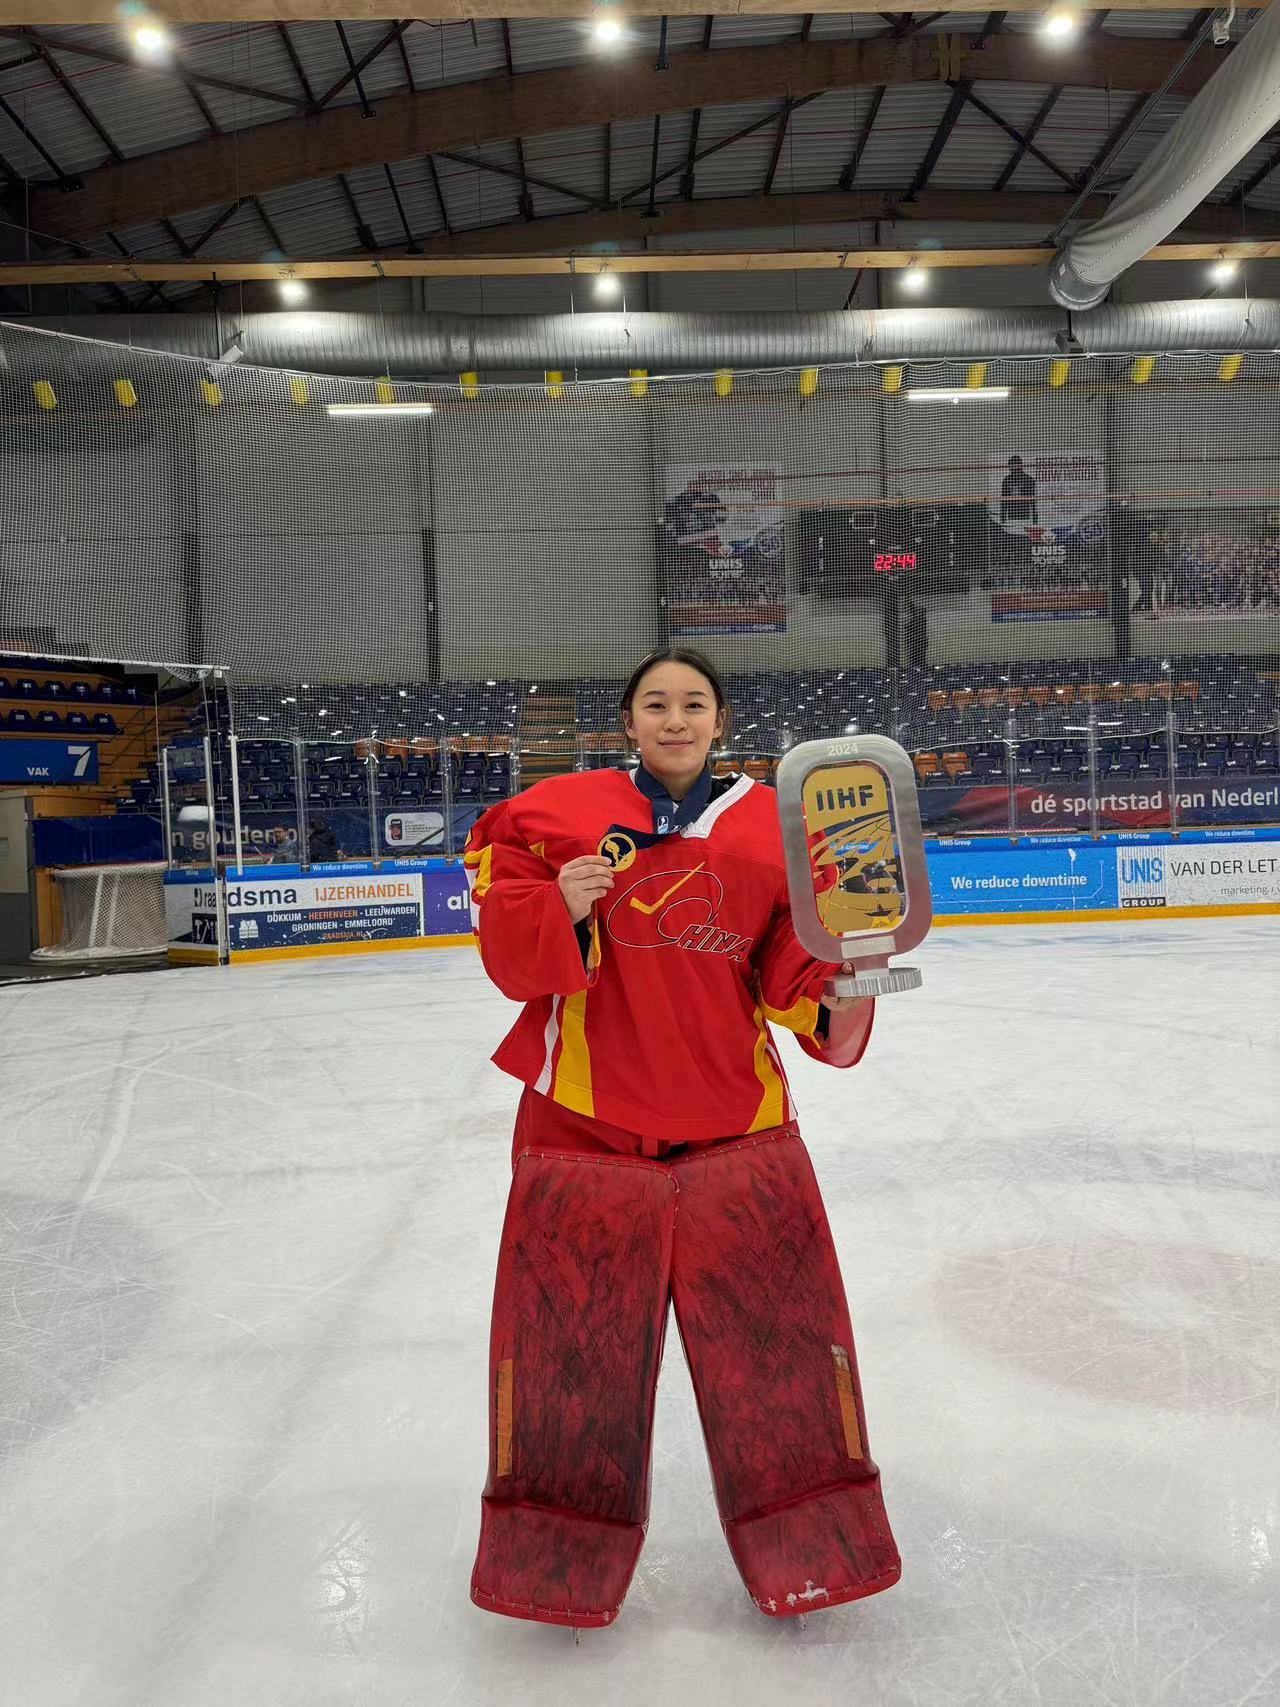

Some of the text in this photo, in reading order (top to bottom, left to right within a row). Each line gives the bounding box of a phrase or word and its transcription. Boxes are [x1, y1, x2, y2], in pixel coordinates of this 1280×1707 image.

[1032, 545, 1066, 555] UNIS
[709, 559, 743, 570] UNIS
[875, 554, 916, 570] 22:44
[828, 743, 858, 756] 2024
[27, 745, 91, 776] VAK 7
[816, 785, 874, 811] IIHF
[1031, 794, 1056, 813] dé
[1063, 791, 1162, 816] sportstad
[1212, 788, 1279, 807] Nederl
[954, 839, 972, 847] Group
[1122, 857, 1163, 884] UNIS
[1170, 861, 1205, 876] VAN
[1211, 860, 1243, 875] DER
[951, 873, 1087, 889] We reduce downtime
[315, 883, 414, 902] IJZERHANDEL
[1123, 898, 1163, 907] GROUP
[267, 906, 416, 923] DOKKUM HEERENVEEN LEEUWARDEN
[291, 917, 393, 933] GRONINGEN EMMELOORD
